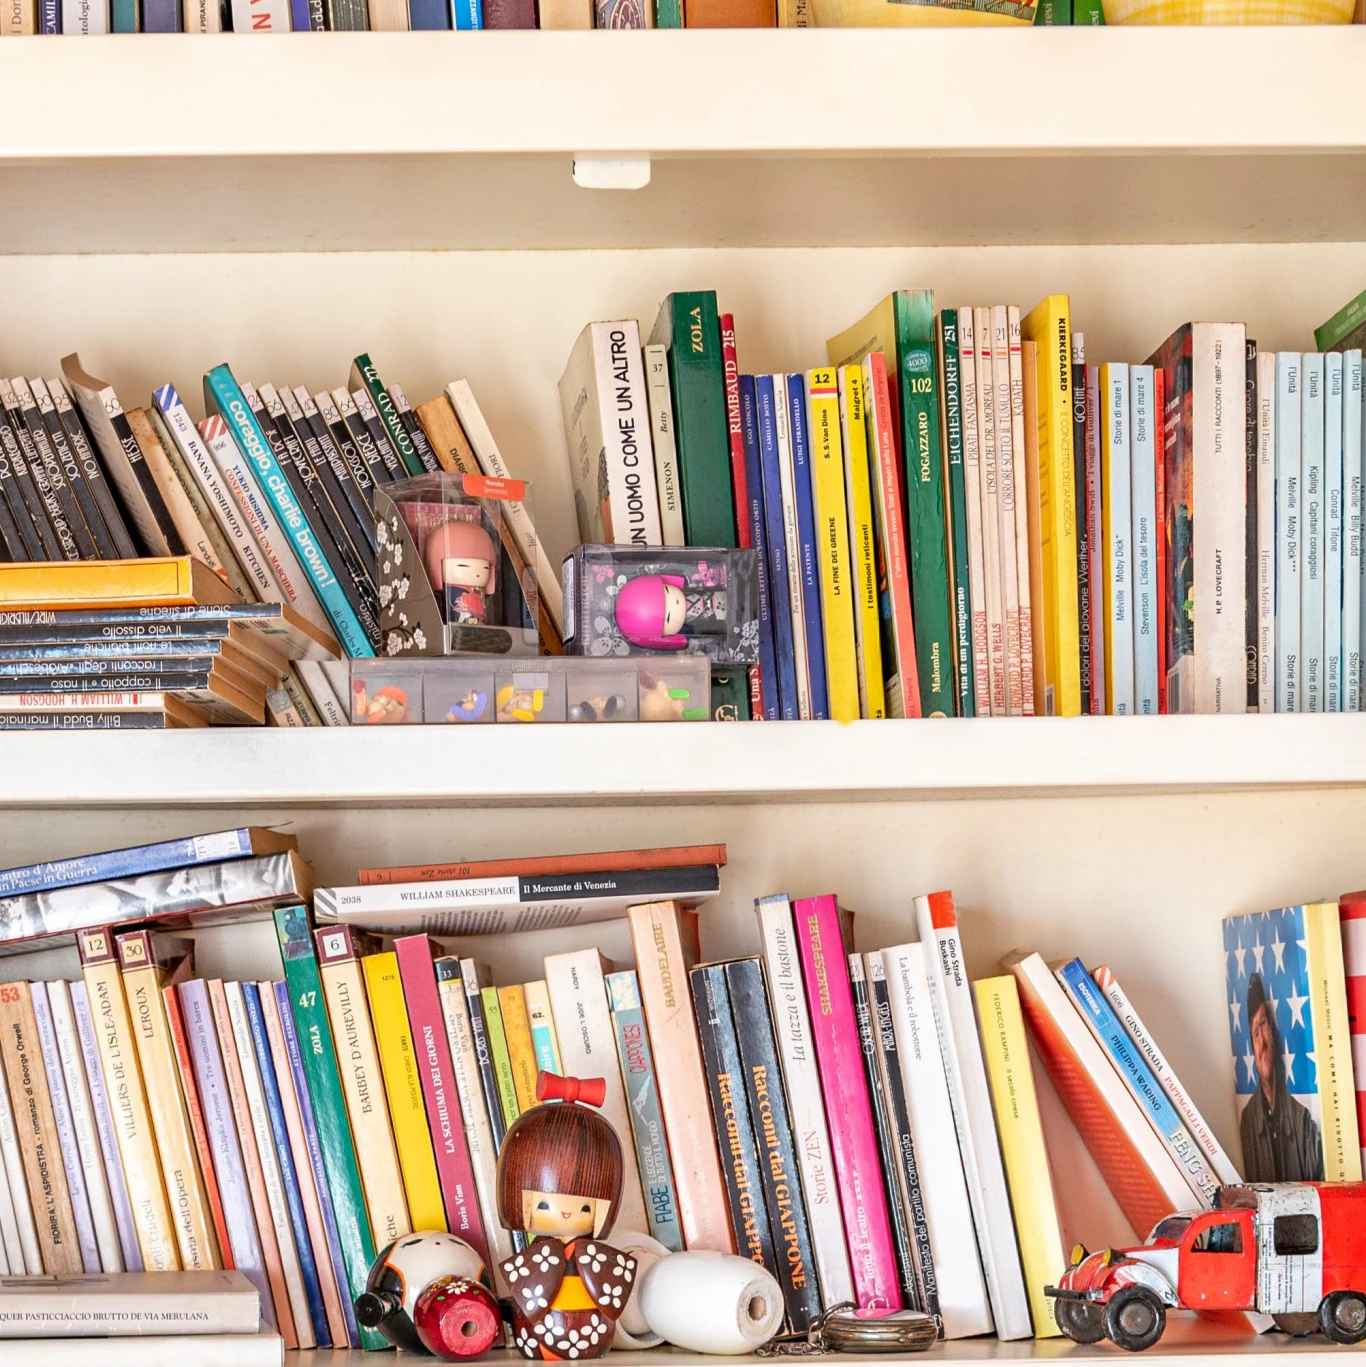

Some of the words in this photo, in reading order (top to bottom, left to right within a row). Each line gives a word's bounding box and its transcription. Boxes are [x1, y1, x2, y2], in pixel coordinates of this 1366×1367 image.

[692, 307, 703, 353] ZOLA
[610, 330, 628, 384] ALTRO
[1058, 318, 1068, 391] KIERKEGAARD
[726, 360, 743, 434] RIMBAUD
[815, 373, 830, 383] 12
[910, 378, 932, 393] 102
[617, 395, 633, 413] UN
[946, 354, 961, 465] EICHENDORFF
[622, 417, 639, 468] COME
[918, 412, 931, 483] FOGAZZARO
[269, 475, 301, 528] charlie
[625, 473, 645, 523] UOMO
[664, 461, 676, 511] SIMENON
[188, 441, 212, 477] BANANA
[211, 478, 243, 538] YOSHIMOTO
[243, 545, 271, 589] KITCHEN
[931, 643, 940, 693] Malombra
[341, 895, 362, 905] 2038
[400, 889, 444, 902] WILLIAM
[445, 885, 516, 899] SHAKESPEARE
[523, 884, 531, 894] Il
[533, 882, 572, 894] Mercante
[574, 881, 583, 891] di
[585, 879, 617, 891] Venezia
[808, 915, 833, 1016] SHAKESPEARE
[1, 988, 21, 1003] 53
[299, 991, 316, 1007] 47
[310, 1026, 323, 1054] ZOLA
[422, 1025, 438, 1062] GIORNI
[430, 1064, 442, 1087] DEI
[436, 1086, 454, 1137] SCHIUMA
[444, 1140, 456, 1155] LA
[806, 1129, 822, 1162] ZEN
[812, 1167, 828, 1206] Storie
[0, 1312, 23, 1323] QUER
[26, 1312, 91, 1322] PASTICCIACCIO
[93, 1312, 128, 1322] BRUTTO
[130, 1312, 141, 1322] DE
[143, 1312, 159, 1322] VIA
[161, 1311, 209, 1321] MERULANA
